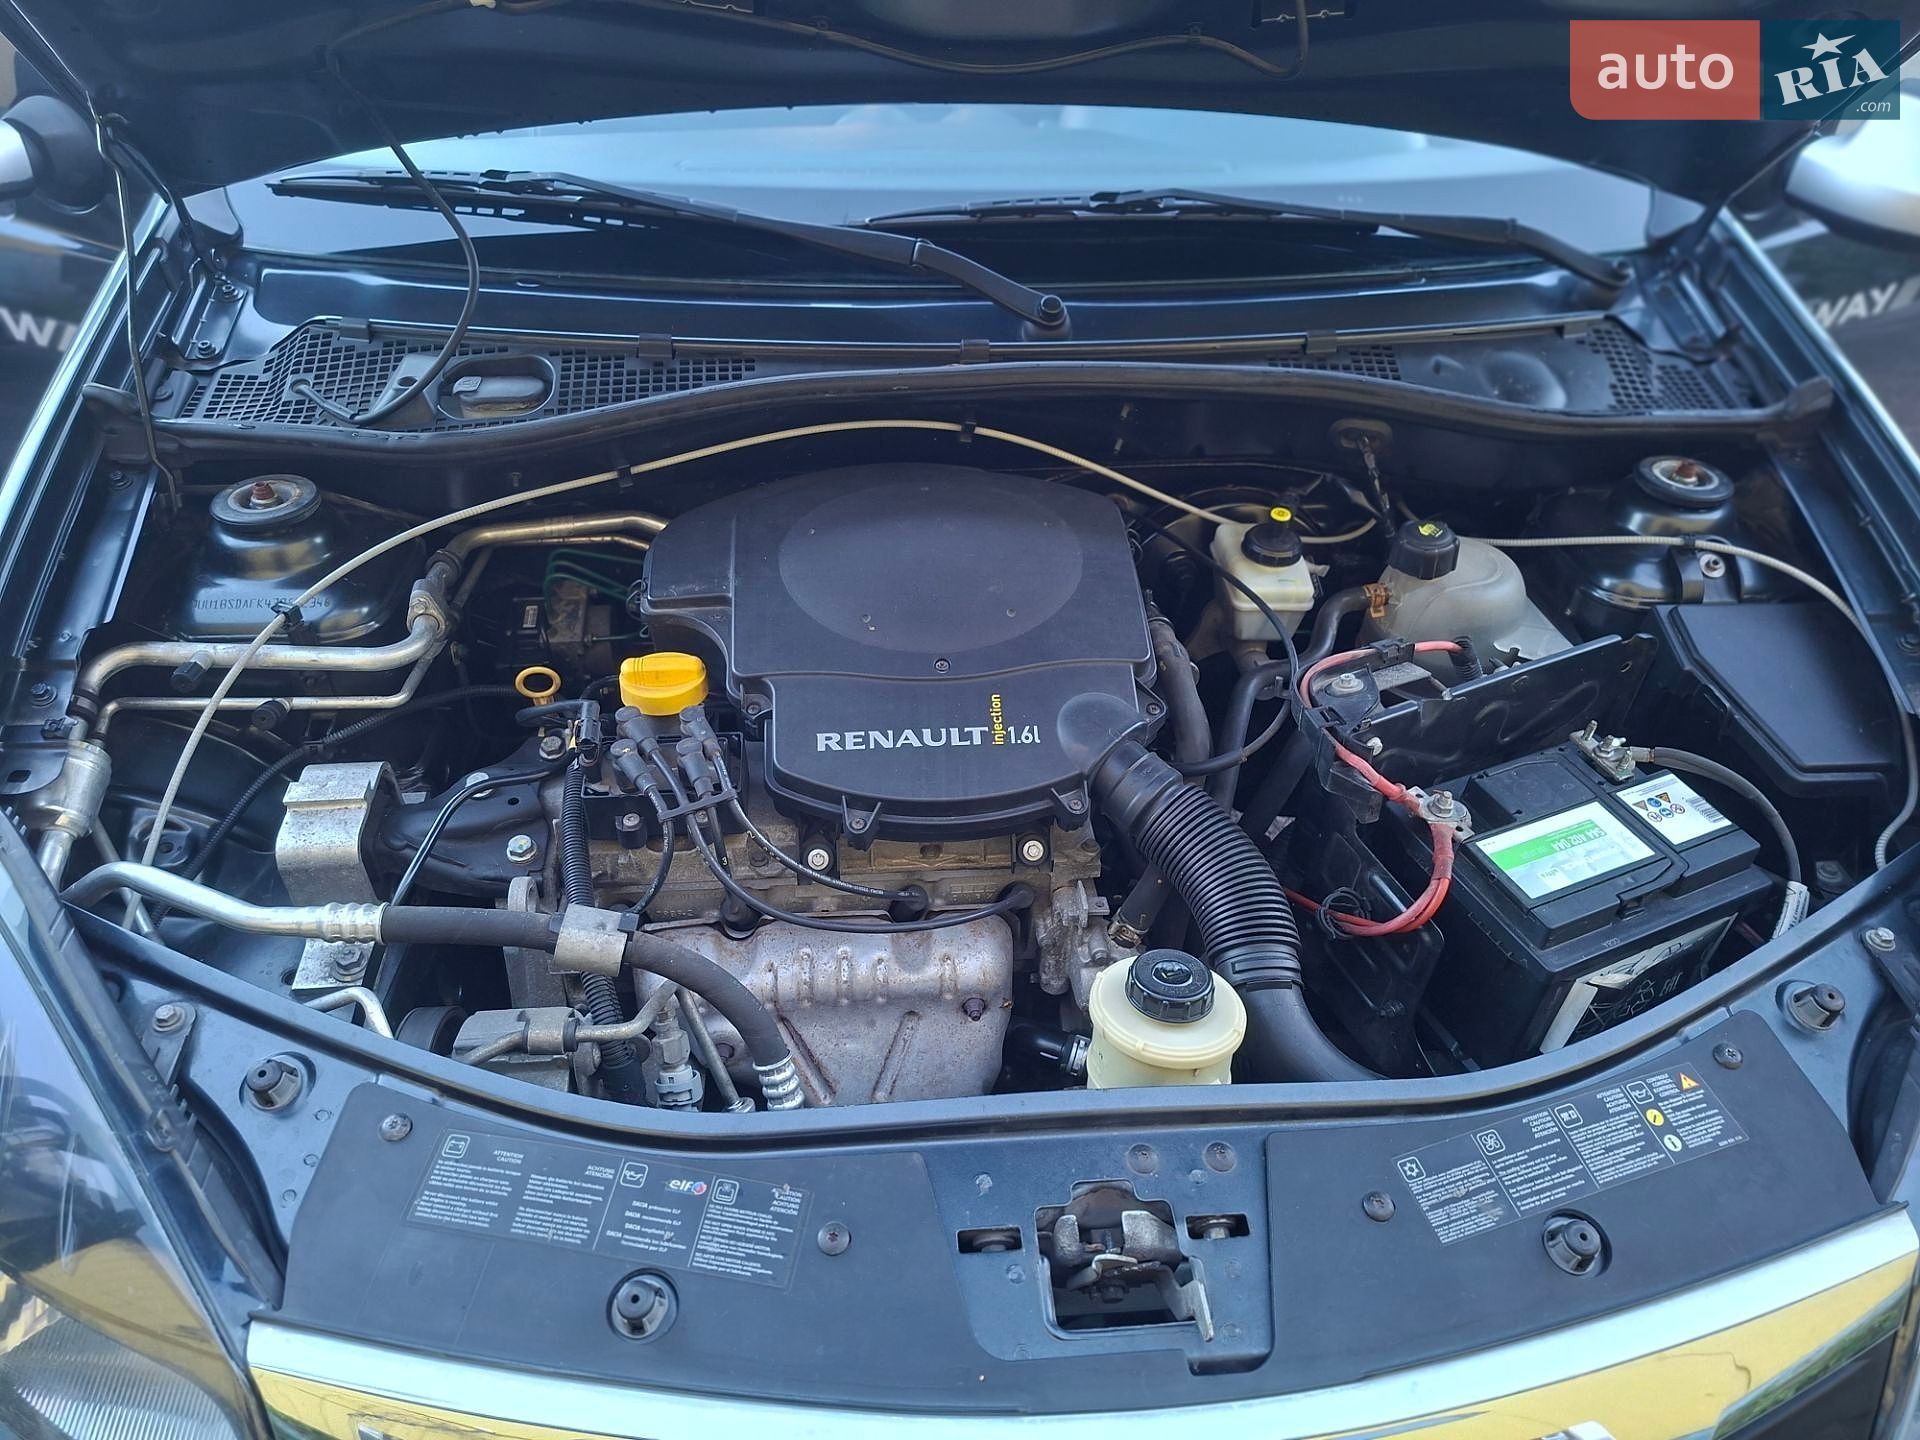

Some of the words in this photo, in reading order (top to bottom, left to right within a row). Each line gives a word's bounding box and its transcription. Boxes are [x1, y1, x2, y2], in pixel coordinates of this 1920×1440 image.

[989, 693, 1006, 745] injection
[816, 727, 988, 751] RENAULT
[1522, 1111, 1549, 1123] ATTENTION
[1530, 1116, 1552, 1126] CAUTION
[1532, 1121, 1555, 1132] ACHTUNG
[493, 1150, 524, 1158] ATTENTION
[497, 1156, 522, 1164] CAUTION
[587, 1165, 615, 1174] ACHTUNG
[669, 1180, 693, 1191] elf
[772, 1200, 799, 1209] ACHTUNG
